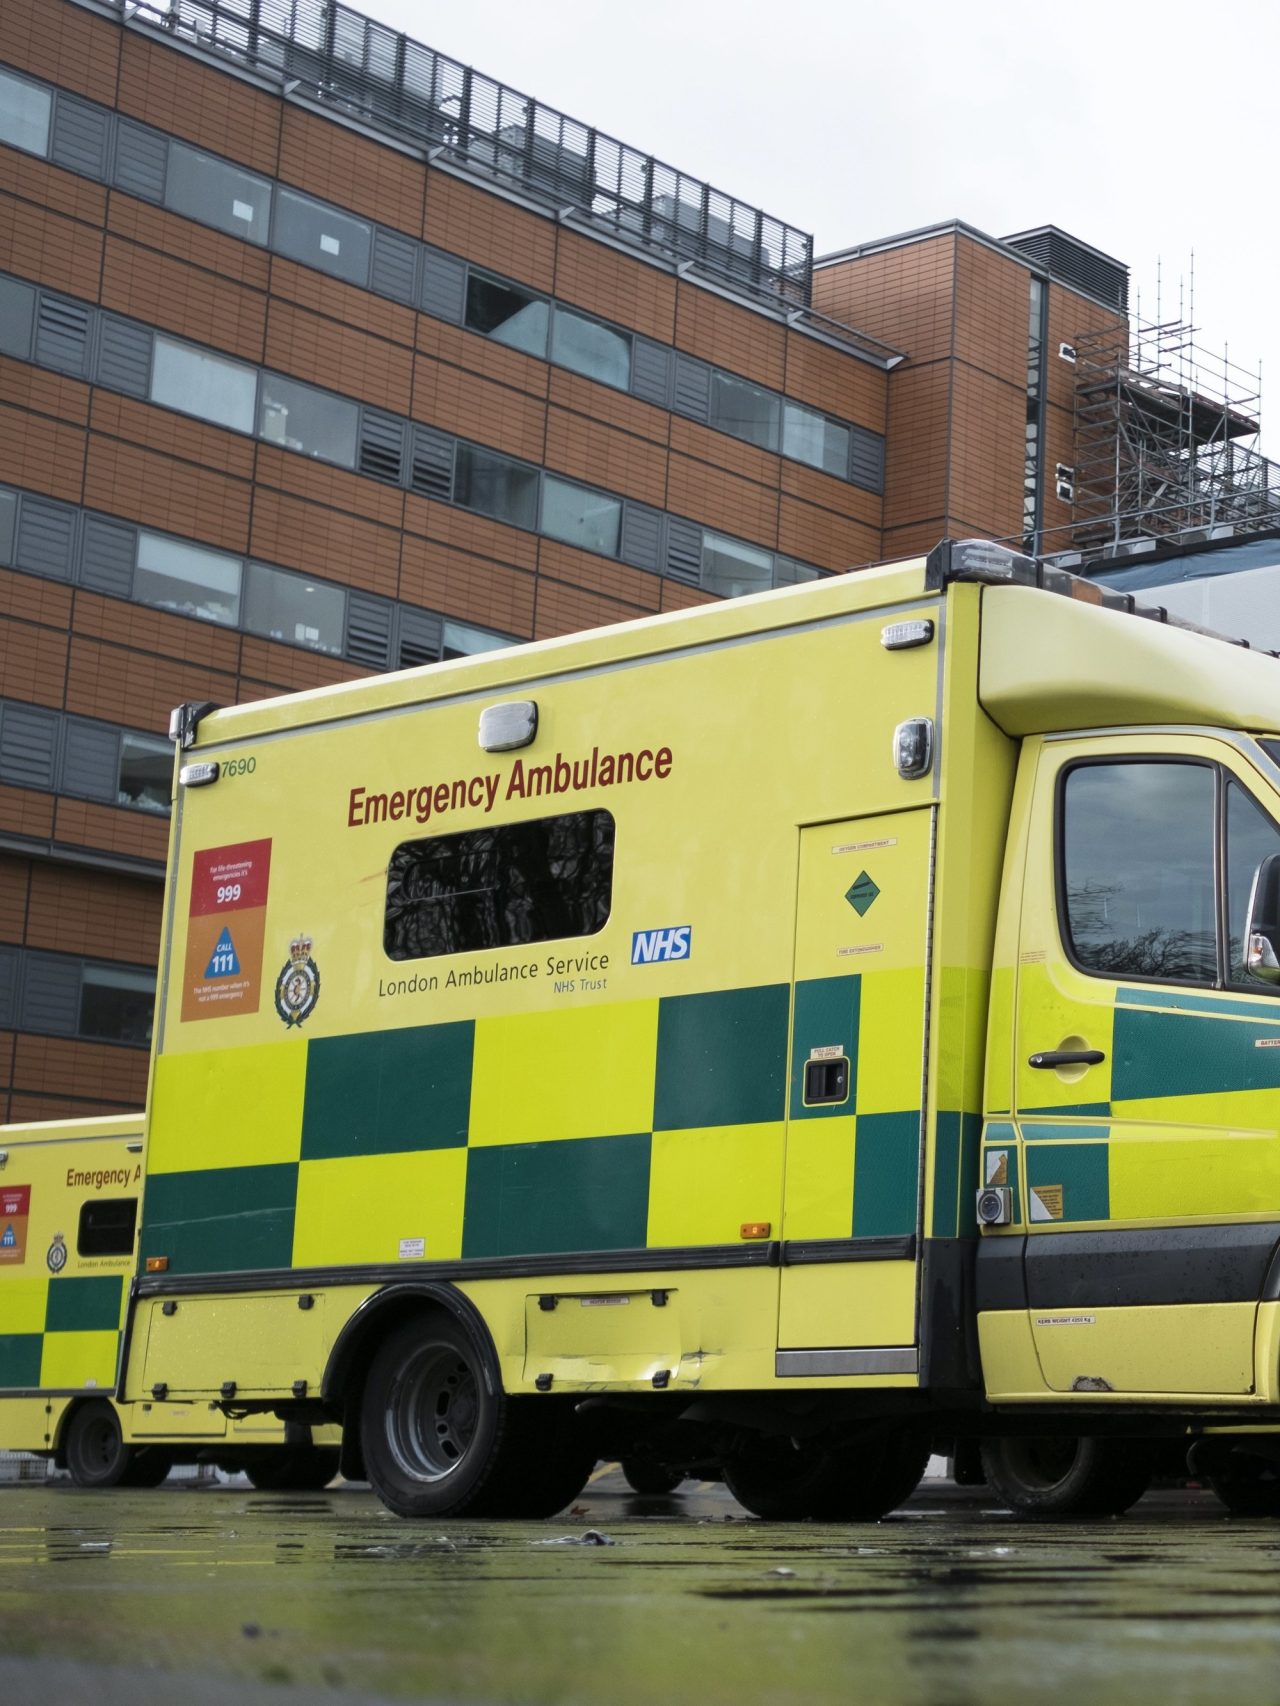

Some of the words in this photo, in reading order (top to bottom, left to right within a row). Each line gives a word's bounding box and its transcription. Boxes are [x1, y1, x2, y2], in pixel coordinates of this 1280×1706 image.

[222, 756, 256, 778] 7690
[348, 773, 500, 827] Emergency
[505, 747, 673, 801] Ambulance
[217, 884, 241, 903] 999
[216, 943, 232, 952] CALL
[632, 927, 690, 964] NHS
[212, 953, 234, 973] 111
[379, 973, 438, 997] London
[445, 962, 538, 988] Ambulance
[546, 951, 609, 976] Service
[553, 979, 575, 993] NHS
[580, 978, 607, 991] Trust
[66, 1168, 131, 1190] Emergency
